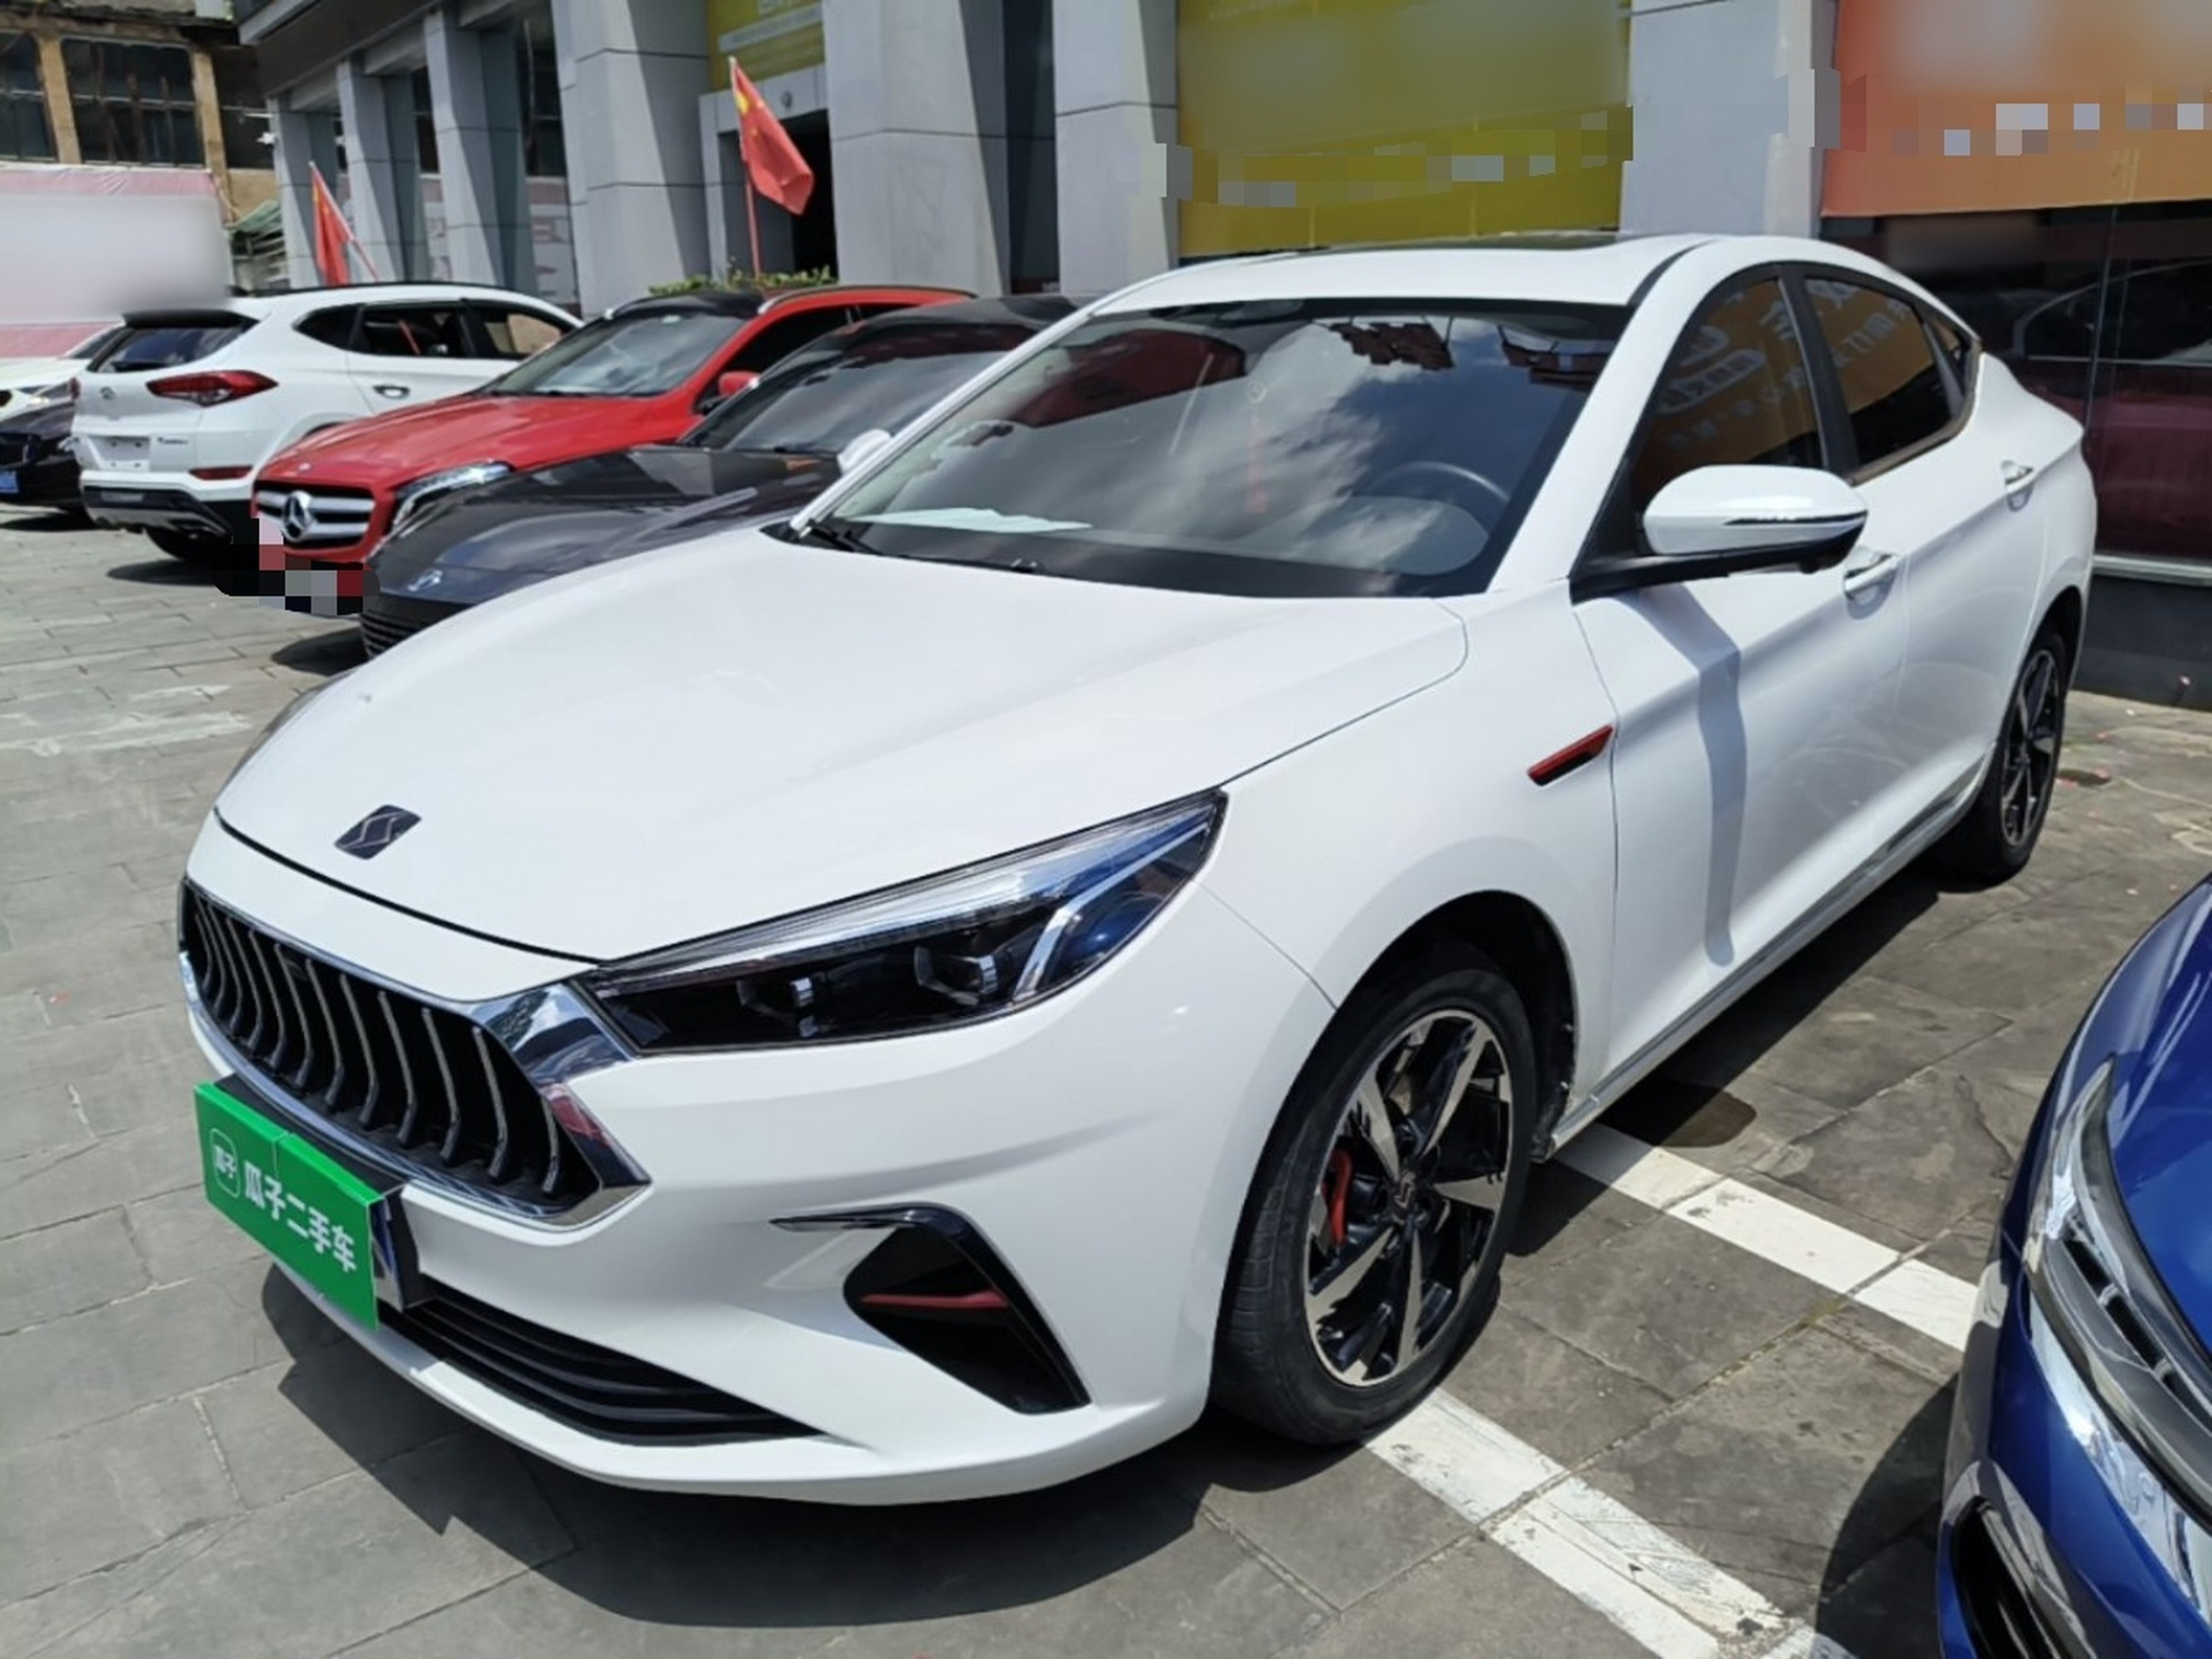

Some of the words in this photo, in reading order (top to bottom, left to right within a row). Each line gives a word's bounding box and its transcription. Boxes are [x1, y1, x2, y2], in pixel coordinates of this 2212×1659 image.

[245, 1160, 357, 1272] 瓜子二手车
